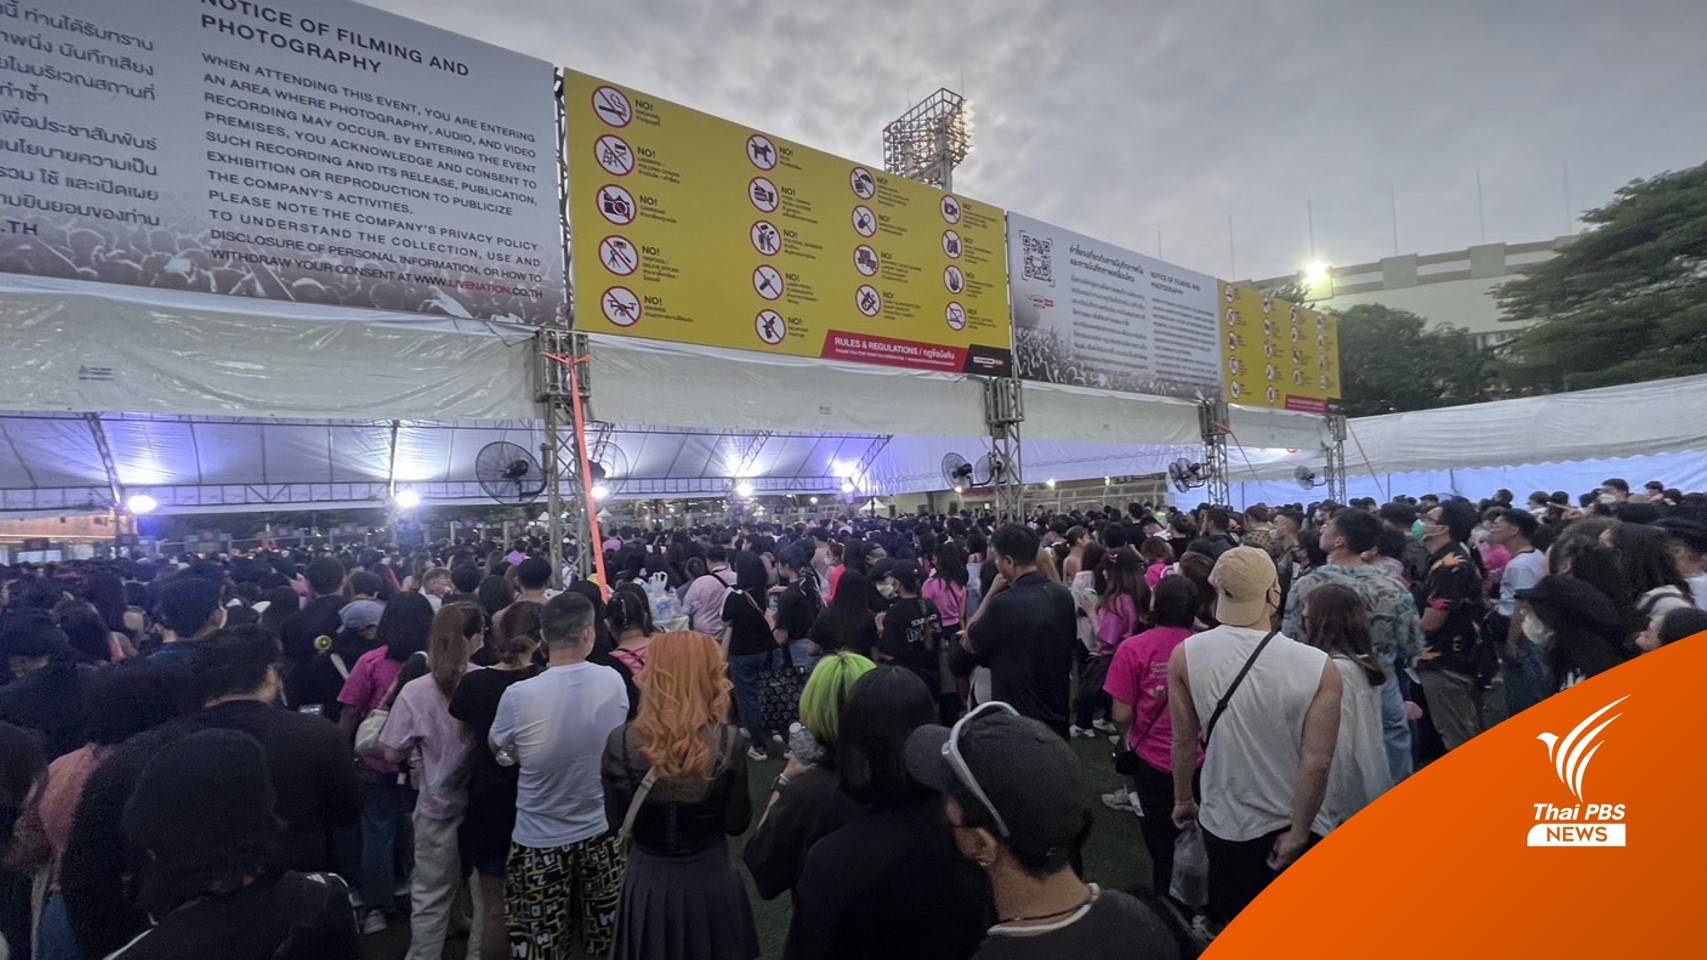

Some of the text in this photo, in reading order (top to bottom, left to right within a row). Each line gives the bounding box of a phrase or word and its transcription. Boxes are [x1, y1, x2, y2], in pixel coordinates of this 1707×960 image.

[0, 0, 154, 51] นี้ ท่านได้รับทราบ
[201, 14, 382, 74] PHOTOGRAPHY
[300, 18, 331, 36] OF
[337, 28, 422, 64] FILMING
[429, 55, 469, 77] AND
[59, 42, 154, 76] บันทึกเสียง
[202, 53, 535, 143] WHEN ATTENDING THIS EVENT, YOU ARE ENTERING
[203, 73, 536, 158] AN AREA WHERE PHOTOGRAPHY, AUDIO, AND VIDEO
[635, 99, 653, 111] NO!
[203, 91, 536, 173] RECORDING MAY OCCUR. BY ENTERING THE EVENT
[205, 111, 537, 189] PREMISES, YOU ACKNOWLEDGE AND CONSENT TO
[637, 146, 656, 158] NO!
[65, 177, 159, 201] และเปิดเผย
[206, 130, 537, 206] SUCH RECORDING AND ITS RELEASE, PUBLICATION,
[207, 151, 513, 216] EXHIBITION OR REPRODUCTION TO PUBLICIZE
[207, 169, 413, 214] THE COMPANY'S ACTIVITIES.
[208, 189, 538, 251] PLEASE NOTE THE COMPANY'S PRIVACY POLICY
[639, 195, 658, 206] NO!
[208, 208, 541, 267] TO UNDERSTAND THE COLLECTION, USE AND
[210, 228, 542, 283] DISCLOSURE OF PERSONAL INFORMATION, OR HOW TO
[641, 245, 660, 256] NO!
[211, 249, 543, 298] WITHDRAW YOUR CONSENT AT WWW.LIVENATION.CO.TH
[644, 295, 662, 306] NO!
[834, 337, 861, 348] RULES
[868, 341, 918, 355] REGULATIONS
